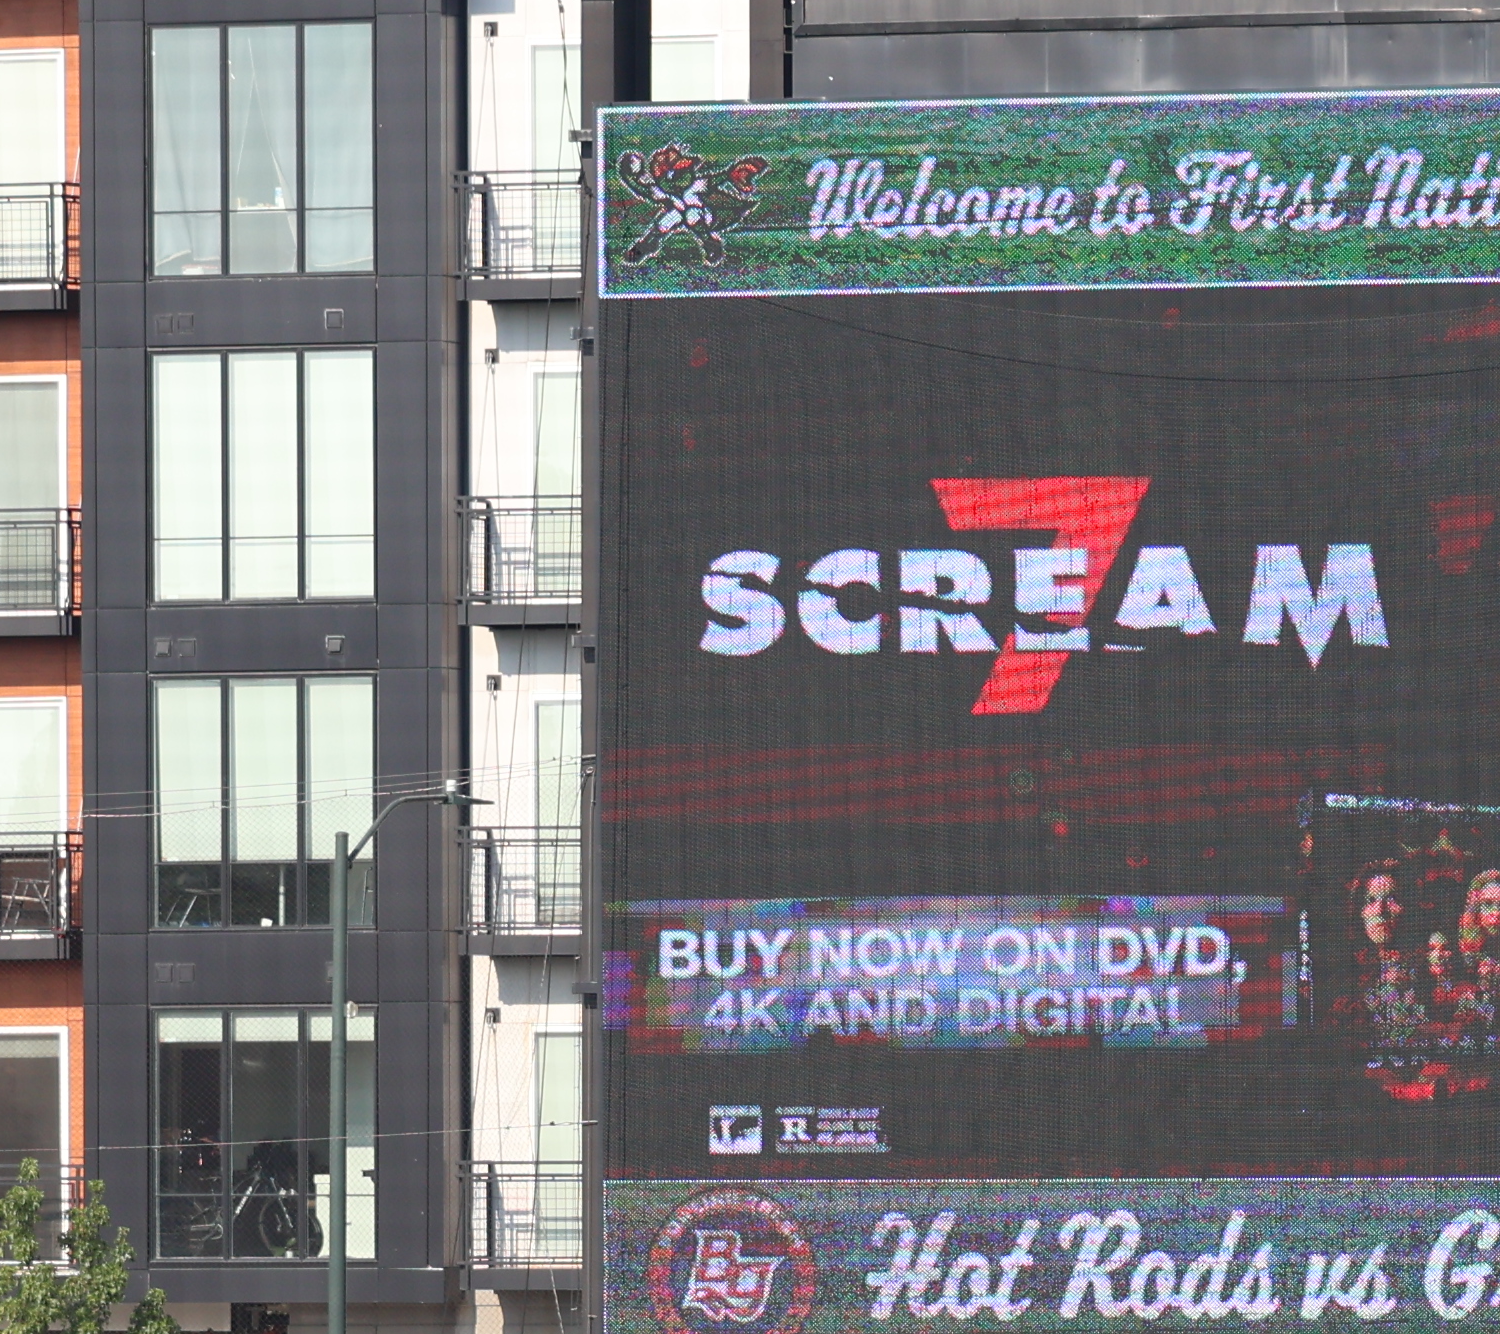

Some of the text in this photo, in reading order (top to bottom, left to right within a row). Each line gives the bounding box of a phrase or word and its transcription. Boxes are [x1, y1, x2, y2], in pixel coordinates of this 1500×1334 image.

[806, 155, 1082, 240] Welcome
[1090, 158, 1154, 235] to
[1171, 149, 1351, 233] First
[699, 544, 1390, 669] SCREAM
[658, 925, 1247, 983] BUY NOW ON DVD,
[703, 987, 1197, 1034] 4K AND DIGITAL
[866, 1209, 1041, 1321] Hot
[1060, 1209, 1281, 1320] Rods
[1301, 1241, 1398, 1320] vs
